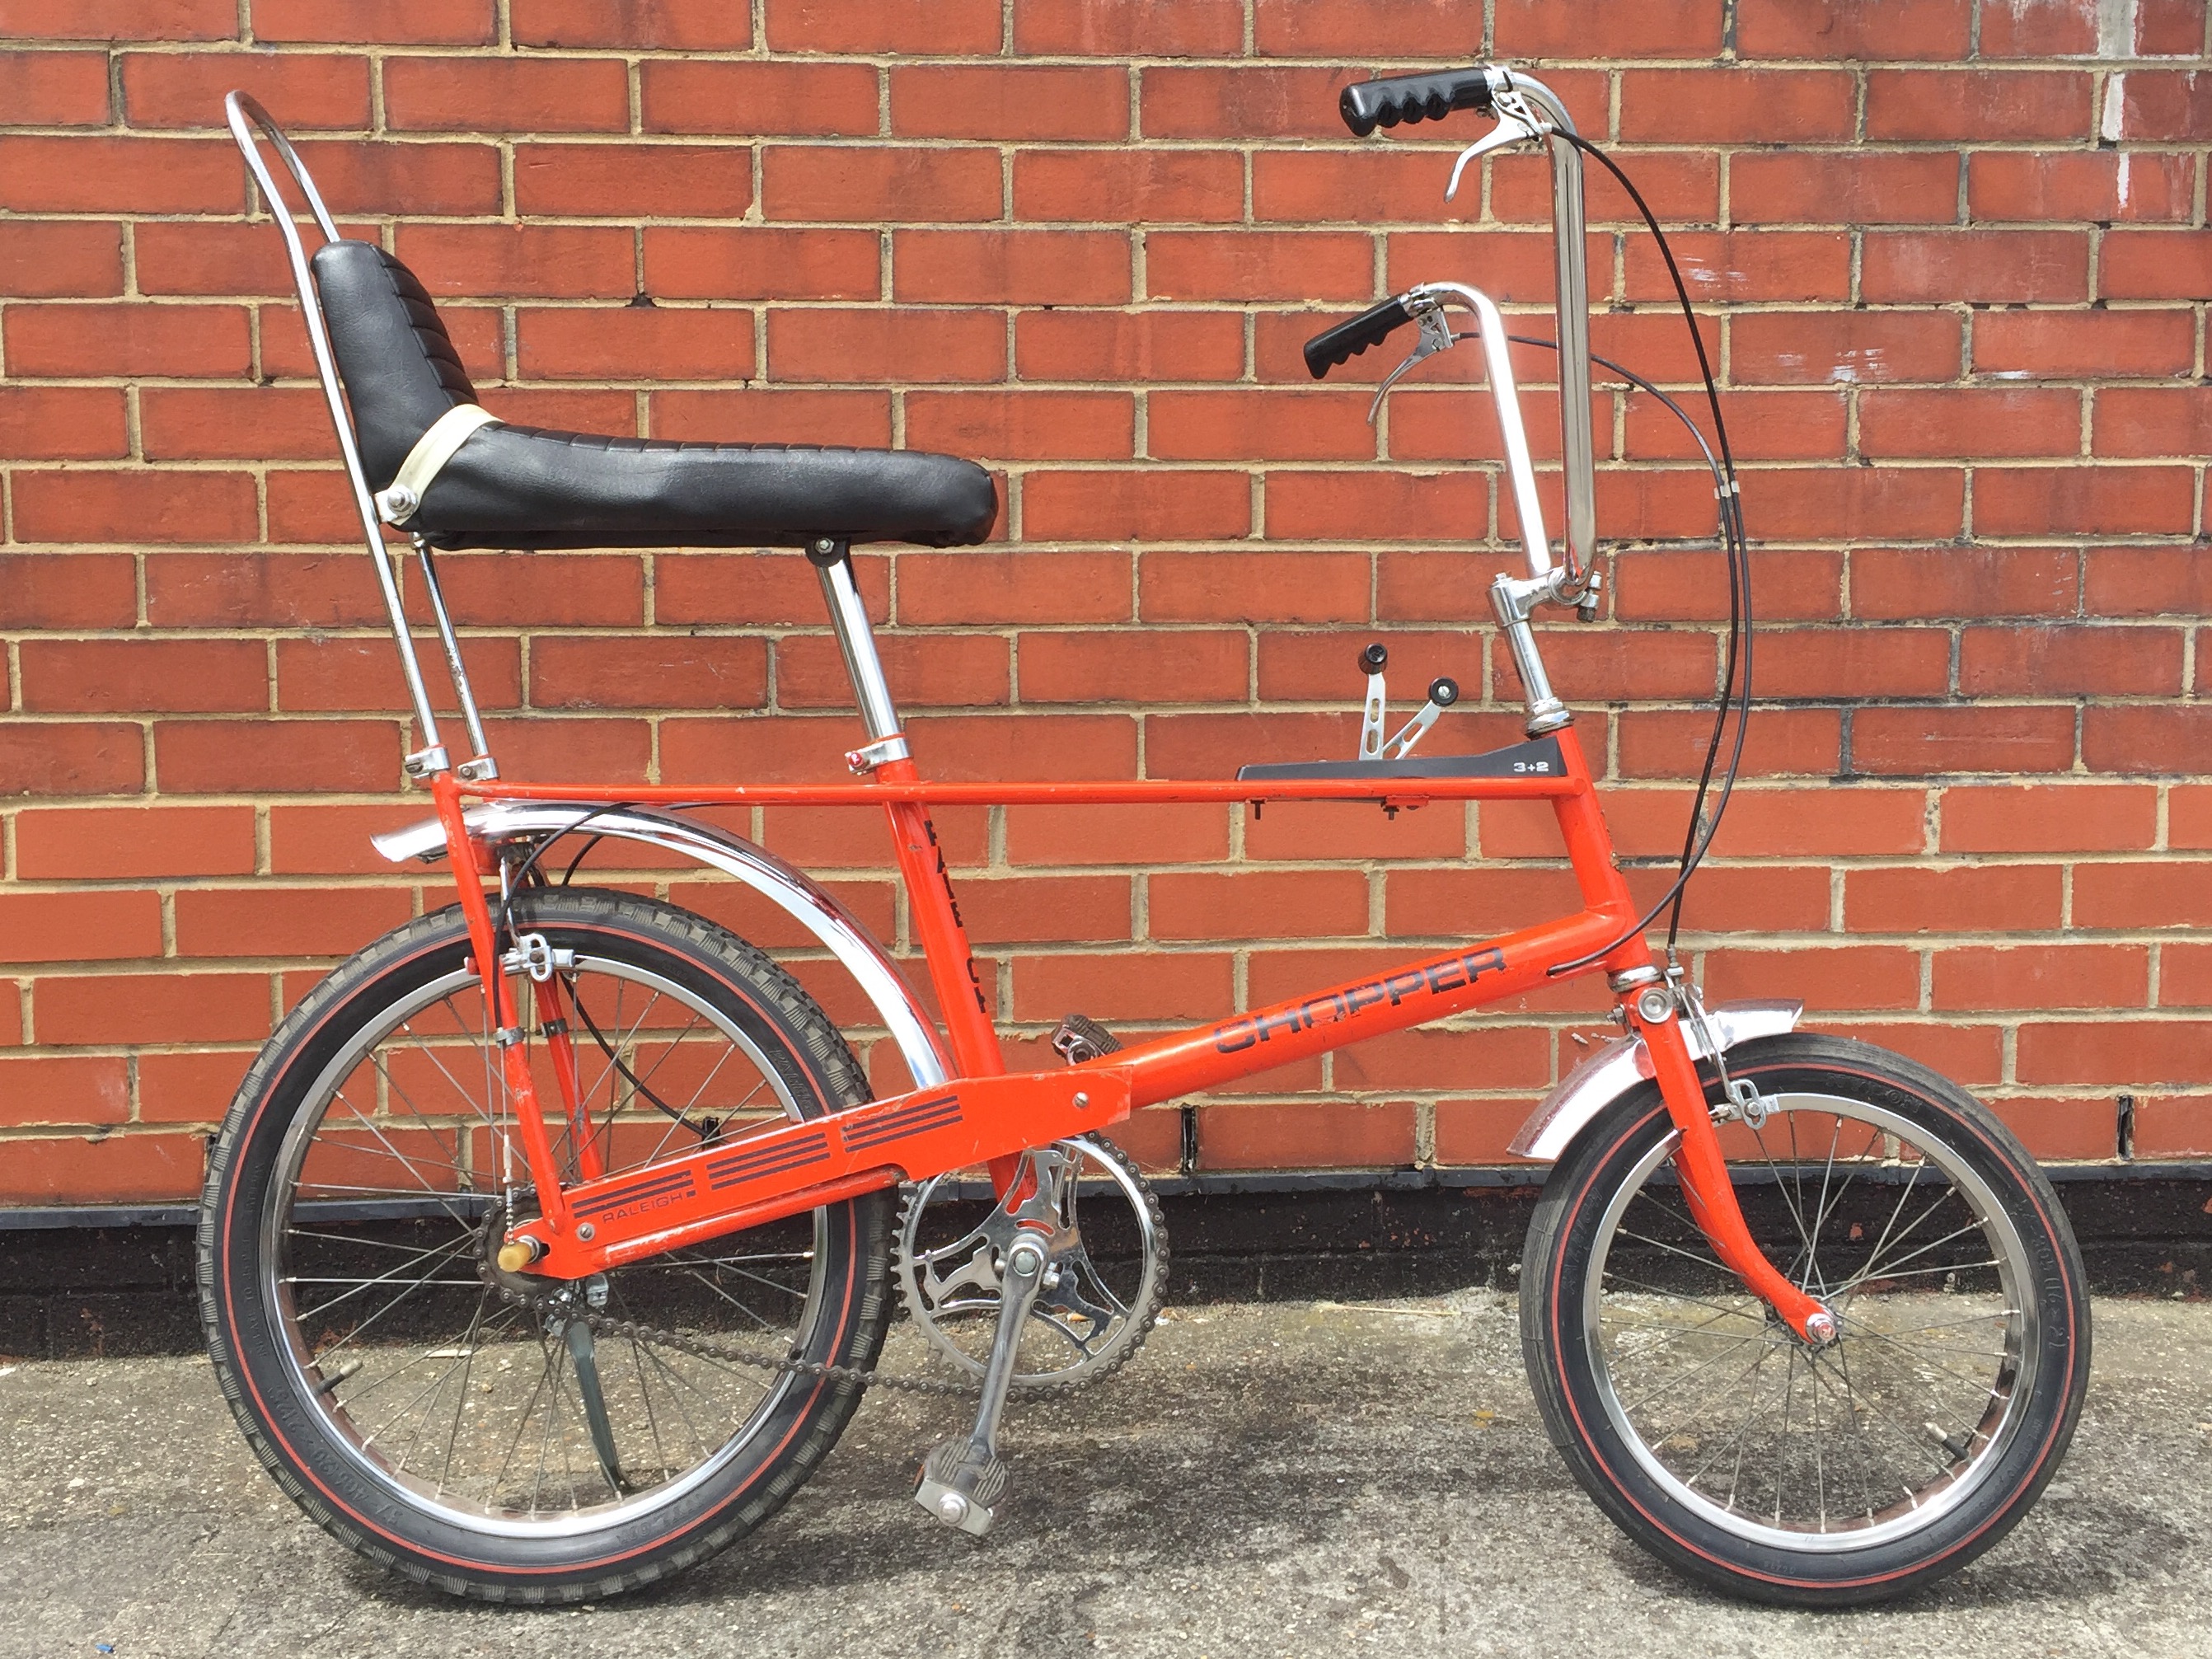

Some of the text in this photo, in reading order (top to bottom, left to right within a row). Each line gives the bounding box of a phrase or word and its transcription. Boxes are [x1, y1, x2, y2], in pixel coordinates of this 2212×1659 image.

[1512, 762, 1549, 772] 3+2
[1214, 947, 1507, 1054] CHOPPER
[602, 1192, 683, 1224] RALEIGH
